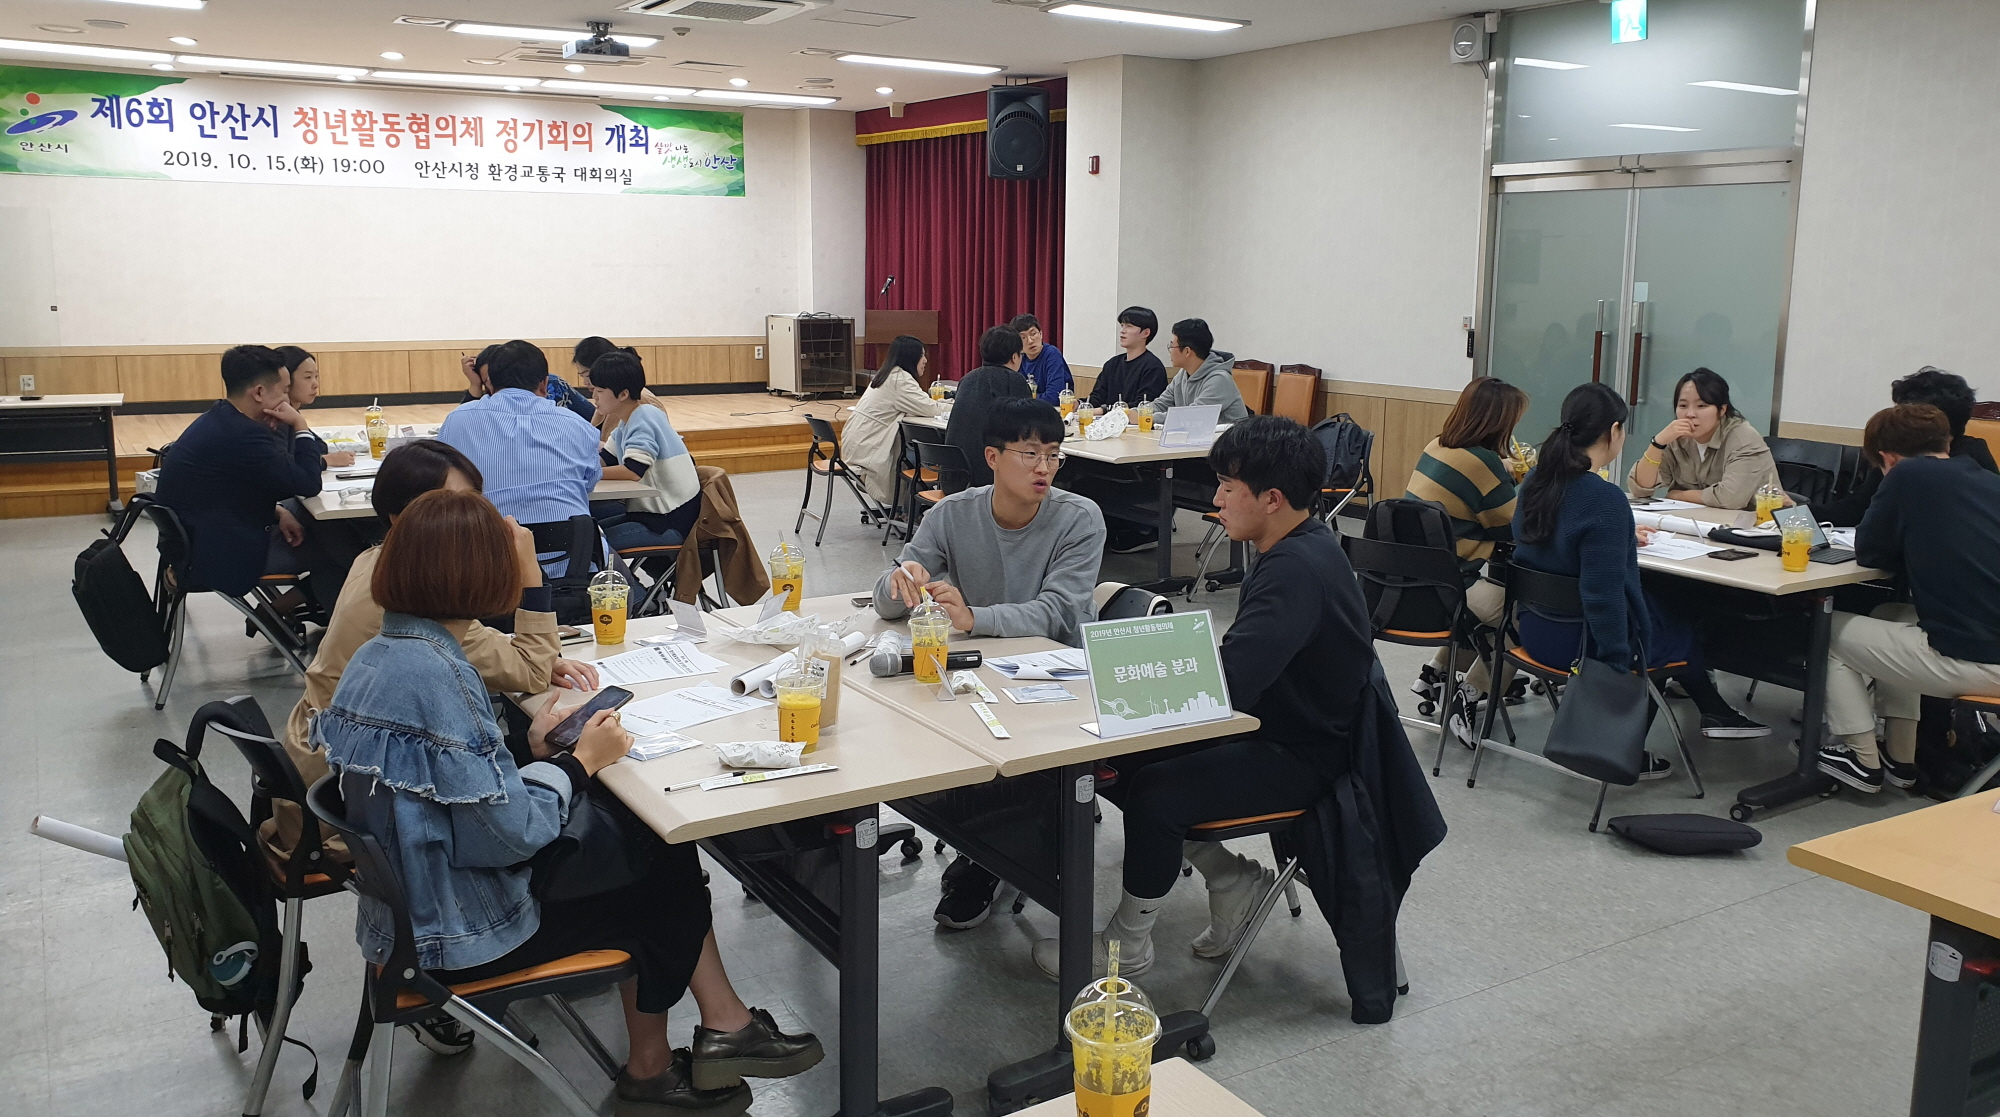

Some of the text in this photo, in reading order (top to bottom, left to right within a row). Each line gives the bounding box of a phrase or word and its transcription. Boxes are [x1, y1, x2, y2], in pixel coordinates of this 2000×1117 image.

[91, 94, 649, 155] 제6회 안산시 청년활동협의체 정기회의 개최
[19, 141, 69, 153] 안산시
[163, 150, 632, 186] 2019. 10. 15.(화) 19:00 안산시청 환경교통국 대회의실
[705, 154, 737, 170] 안산
[1090, 629, 1112, 638] 2019년
[1114, 626, 1132, 636] 안산시
[1113, 657, 1199, 684] 문화예술 분과
